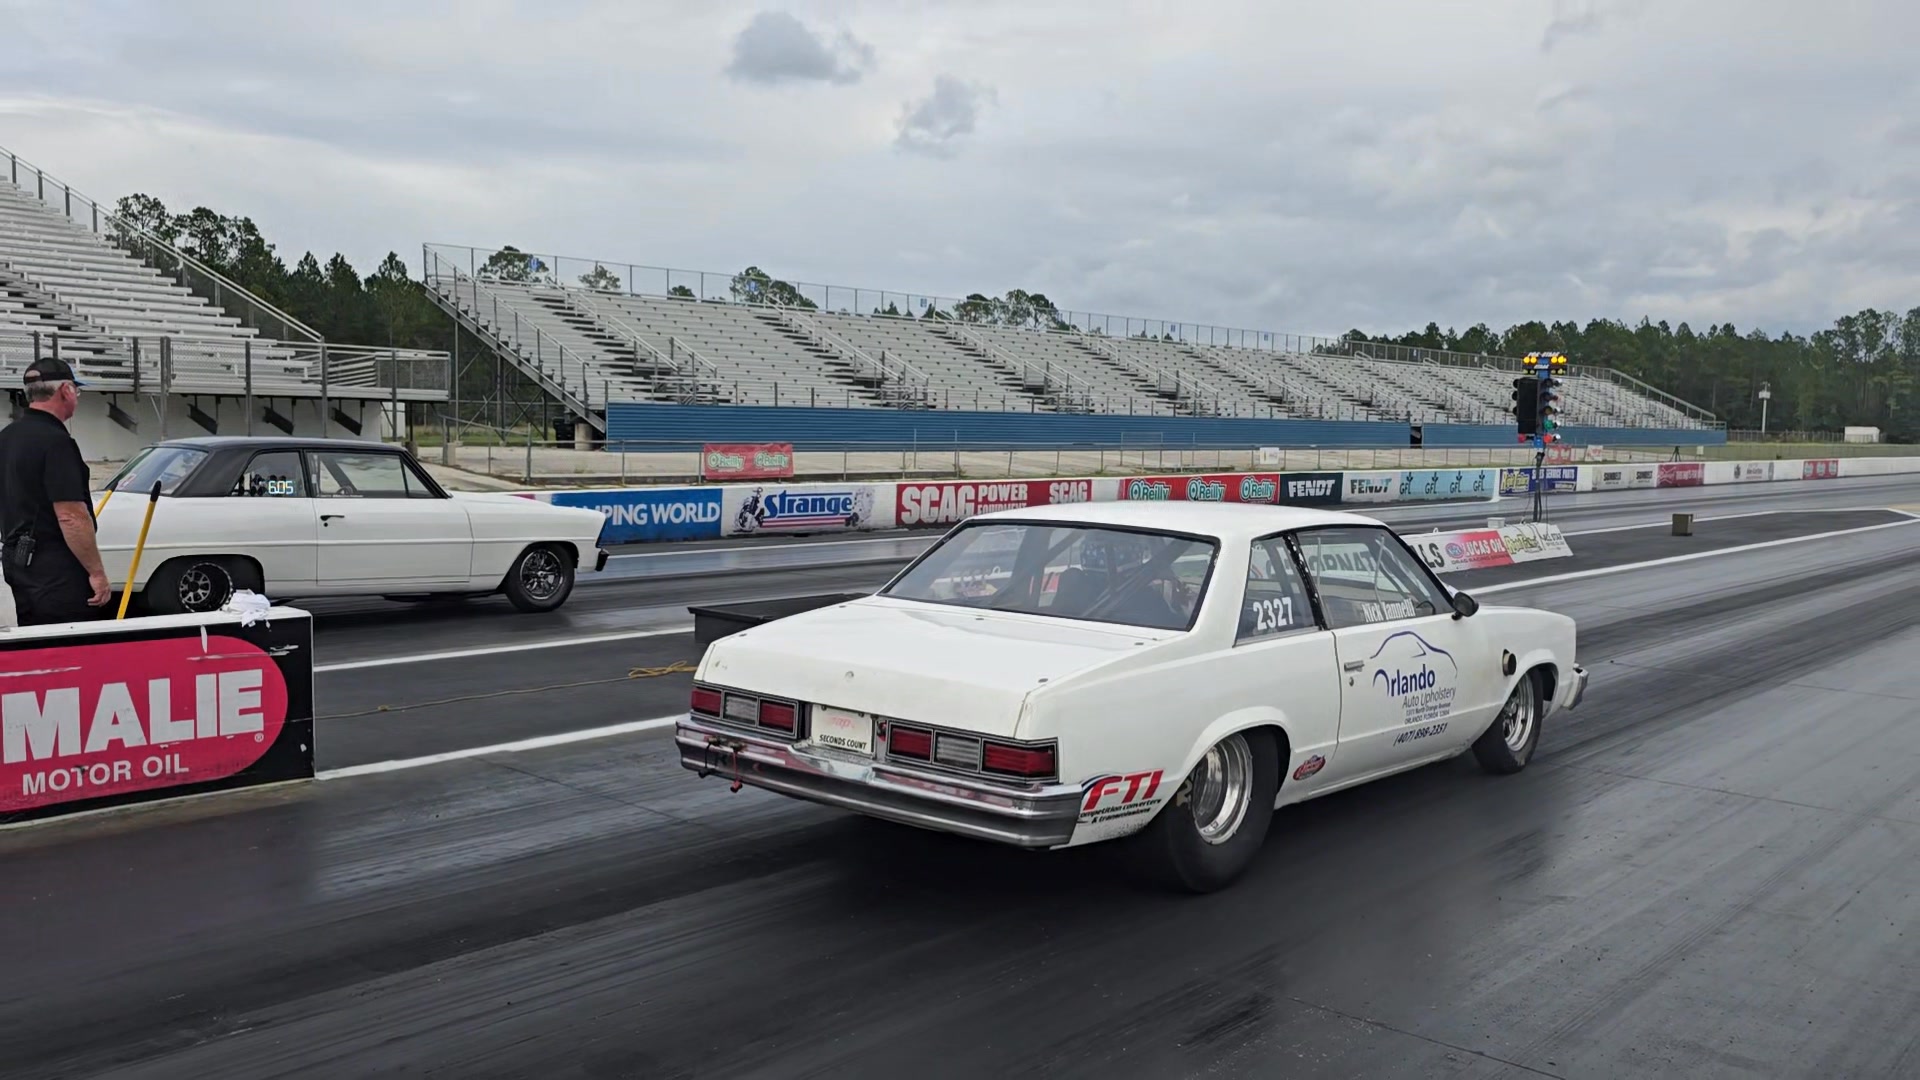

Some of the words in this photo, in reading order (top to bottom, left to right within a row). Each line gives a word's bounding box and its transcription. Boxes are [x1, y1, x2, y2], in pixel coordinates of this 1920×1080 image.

[977, 483, 1028, 502] POWER
[1049, 482, 1087, 503] SCAG
[1130, 479, 1170, 500] O'Reilly
[1187, 479, 1225, 501] O'Reilly
[1241, 477, 1275, 500] O'Reilly
[1288, 479, 1335, 498] FENDT
[1350, 478, 1392, 494] FENDT
[651, 502, 721, 525] WORLD
[764, 490, 853, 518] Strange
[901, 485, 975, 524] SCAG
[1465, 540, 1491, 557] LUCAS
[1490, 538, 1506, 553] OIL
[1253, 596, 1293, 631] 2327
[1361, 602, 1384, 623] Nick
[1373, 663, 1436, 697] Orlando
[1402, 696, 1420, 709] Auto
[1420, 687, 1456, 707] Upholstery
[2, 669, 264, 764] MALIE
[819, 734, 846, 746] SECONDS
[846, 739, 867, 750] COUNT
[1393, 729, 1416, 747] (407)
[22, 759, 132, 796] MOTOR
[142, 753, 189, 778] OIL
[1083, 769, 1164, 811] FTI
[1122, 799, 1161, 811] converters
[1092, 817, 1097, 825] &
[1099, 808, 1152, 822] transmissions
